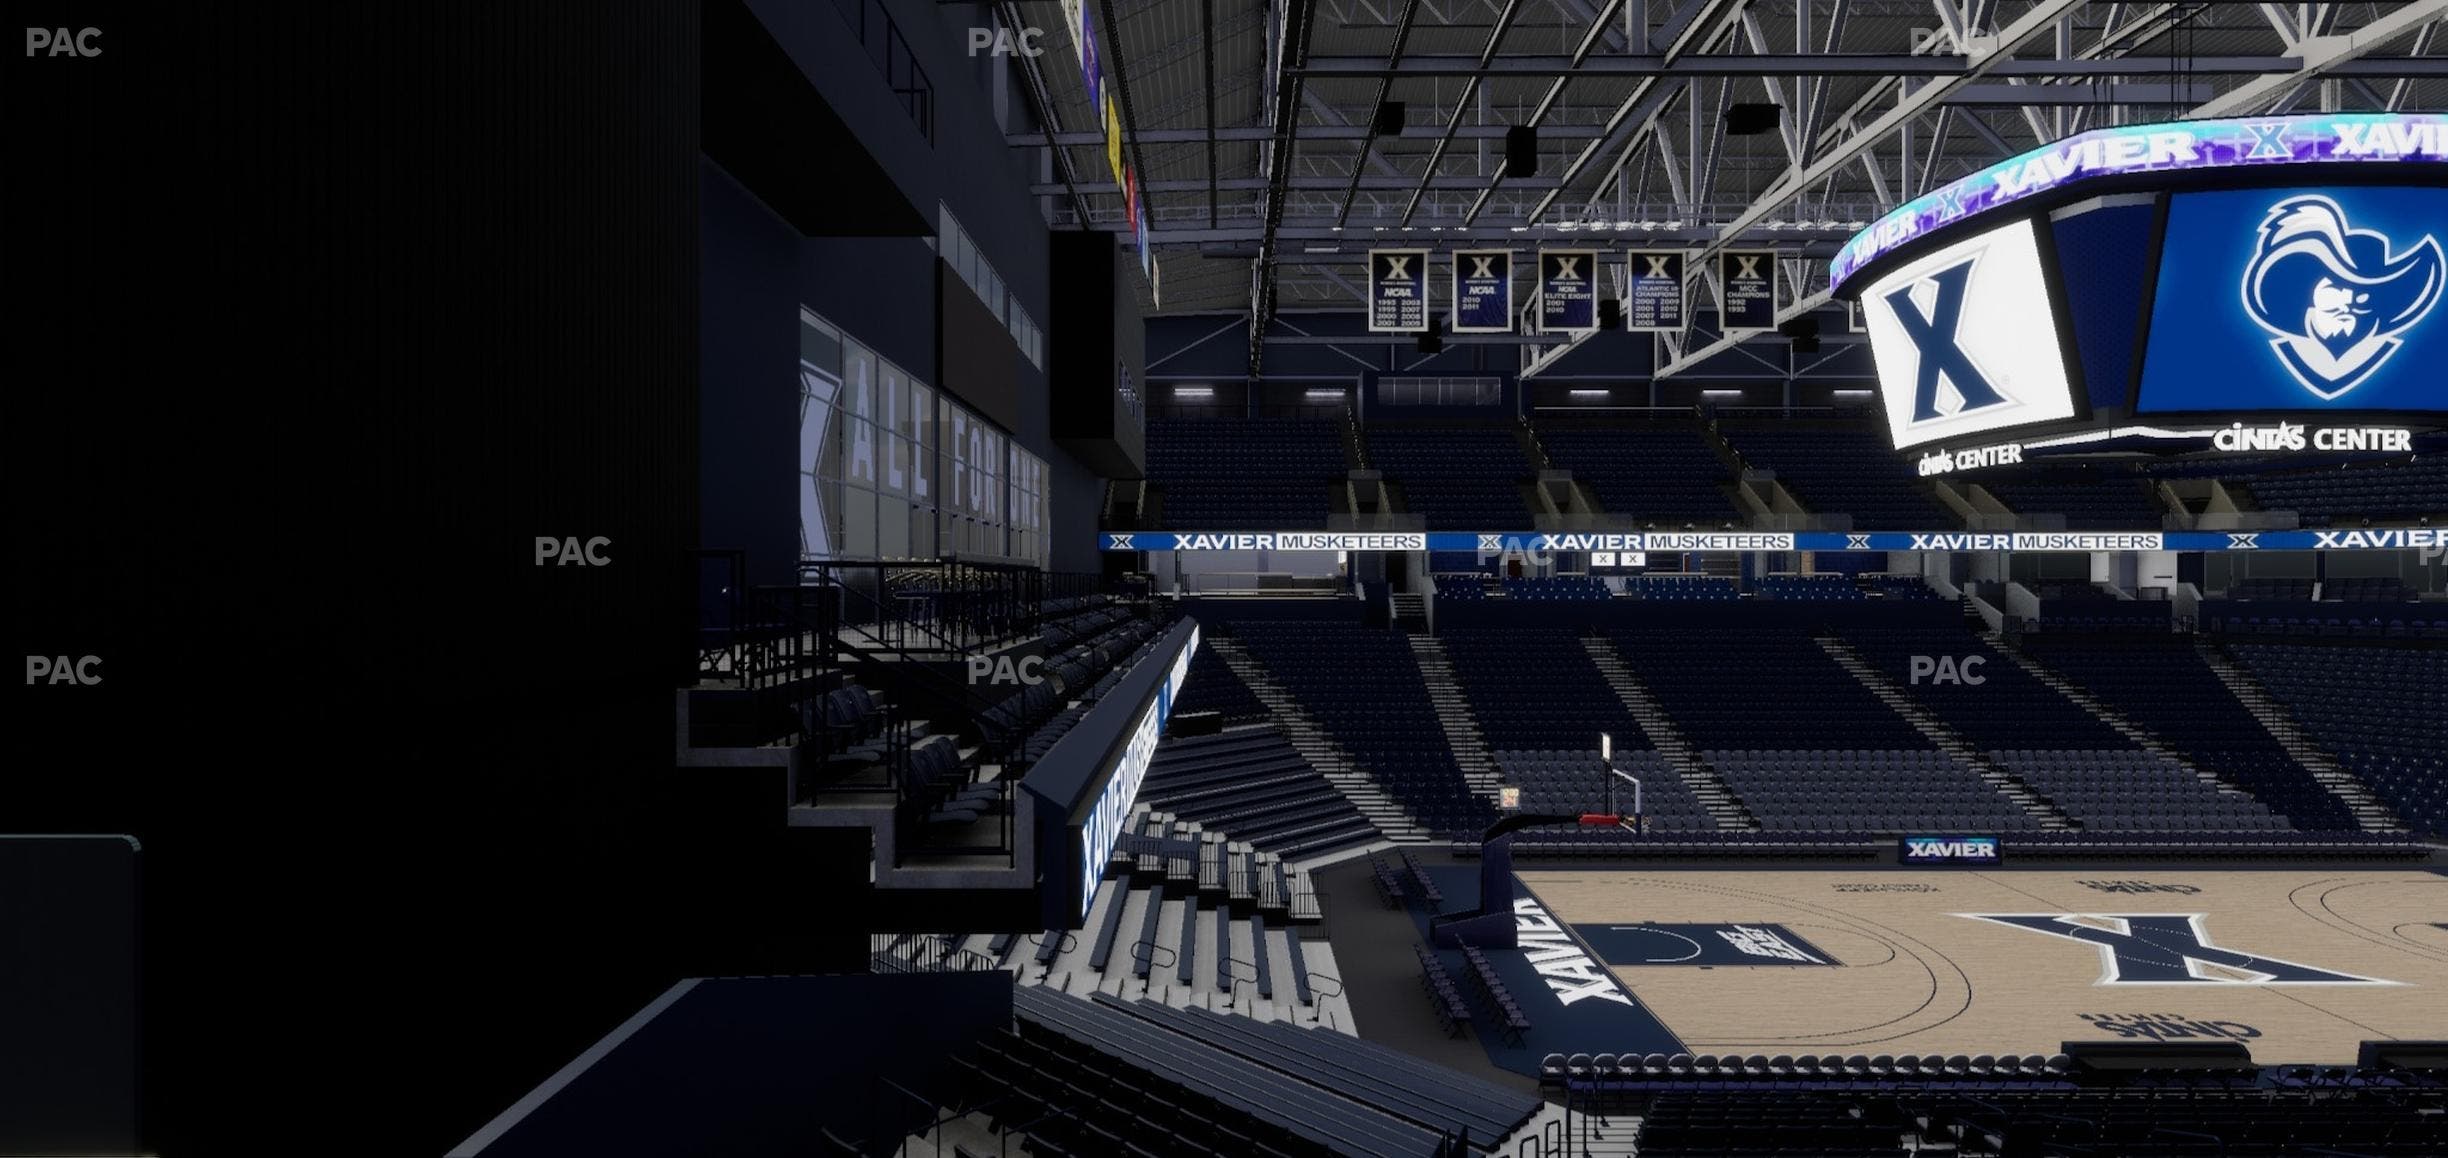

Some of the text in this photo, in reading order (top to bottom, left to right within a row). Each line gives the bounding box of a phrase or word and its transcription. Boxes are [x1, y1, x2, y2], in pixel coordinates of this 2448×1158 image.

[1991, 131, 2199, 201] XAVIER
[1852, 209, 1918, 268] XAVIER
[1384, 256, 1411, 280] X
[1470, 256, 1496, 279] X
[1554, 256, 1581, 280] X
[1645, 256, 1671, 279] X
[1734, 256, 1761, 279] X
[1384, 288, 1413, 297] NCAA
[1469, 286, 1497, 295] NCAA
[1880, 252, 2015, 426] X
[852, 357, 928, 497] ALL
[954, 414, 996, 514] FOR
[2313, 428, 2413, 451] CENTER
[1955, 444, 2024, 469] CENTER
[1174, 534, 1421, 550] XAVIER MUSKETEERS
[1543, 534, 1789, 550] XAVIER MUSKETEERS
[1910, 534, 2159, 550] XAVIER MUSKETEERS
[1082, 757, 1130, 924] XAVIER
[1907, 842, 1996, 858] XAVIER
